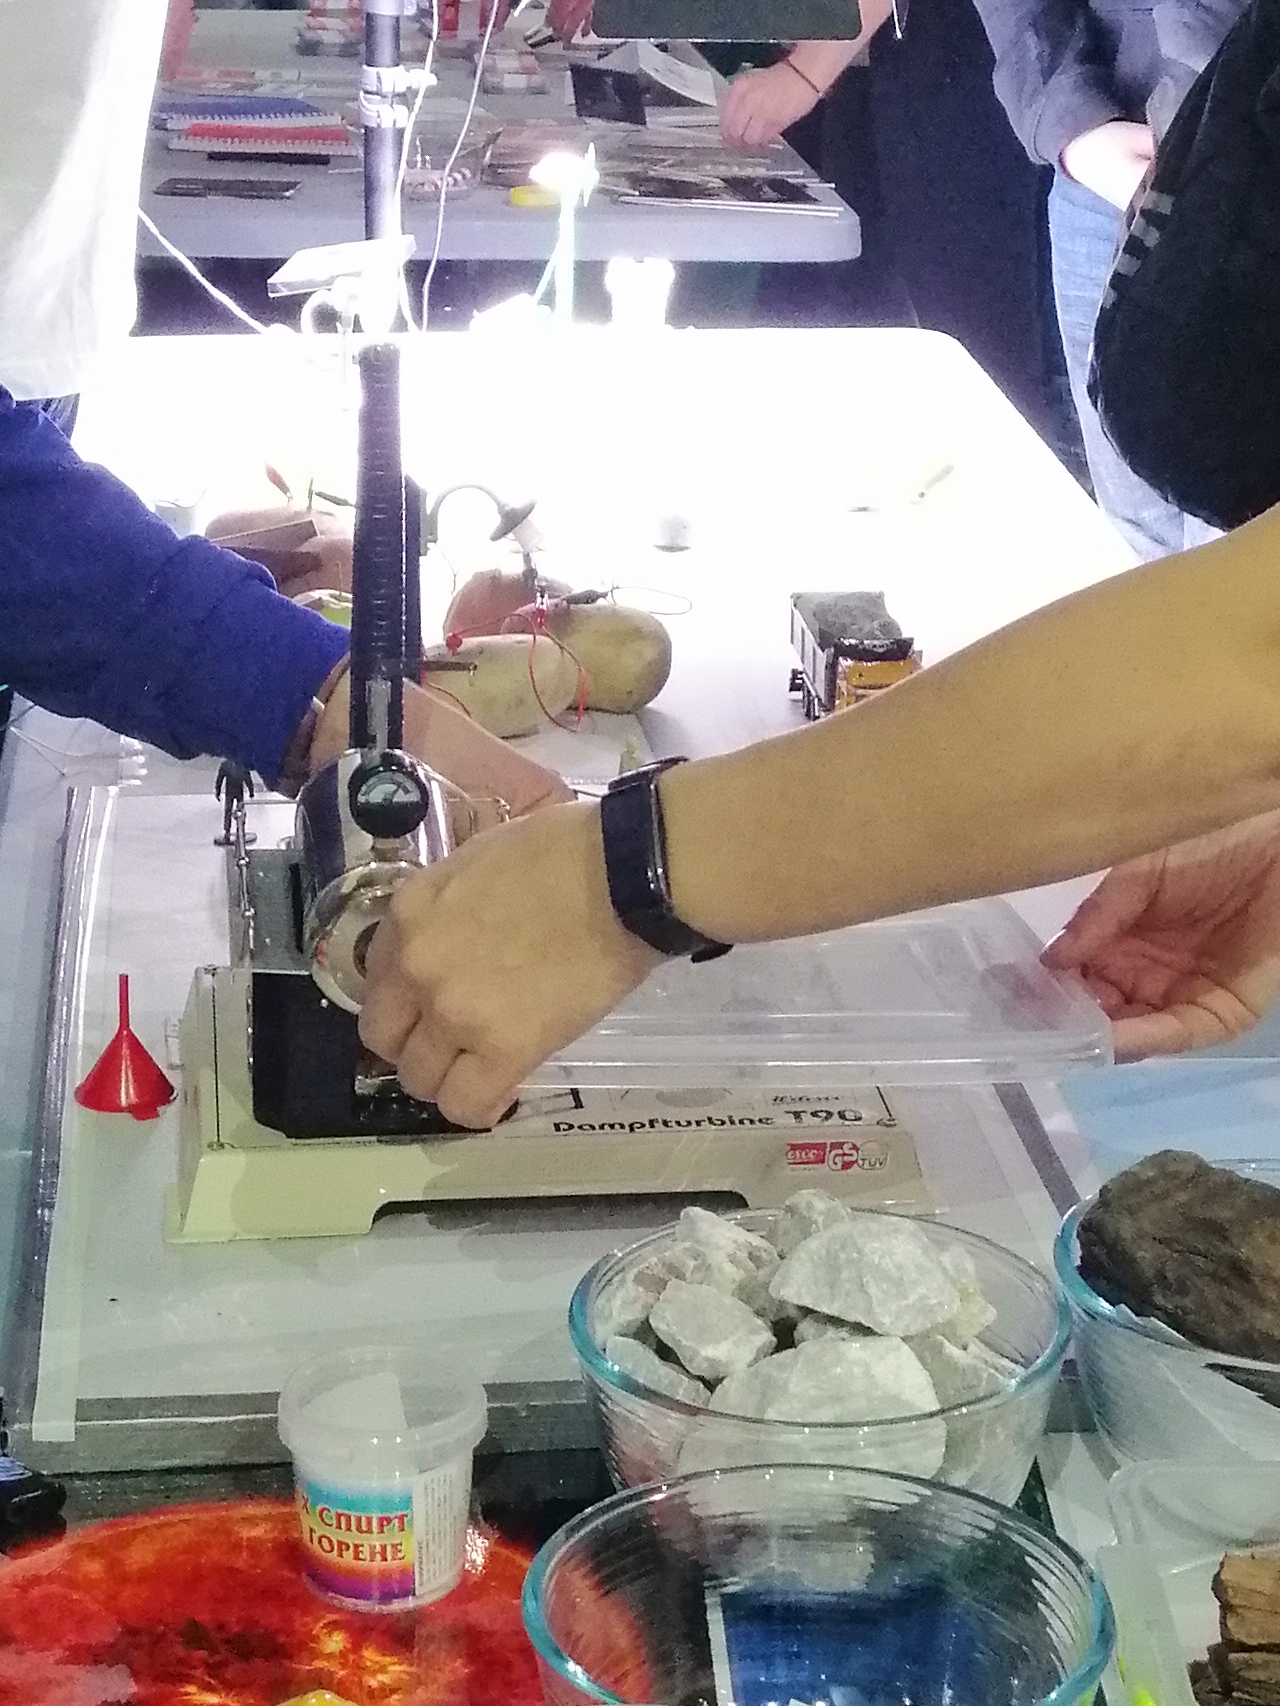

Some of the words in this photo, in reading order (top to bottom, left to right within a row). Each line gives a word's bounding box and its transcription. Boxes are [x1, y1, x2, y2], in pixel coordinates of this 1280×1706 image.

[553, 1112, 774, 1134] Dampfturbine
[784, 1108, 864, 1123] T90
[318, 1505, 409, 1535] СПИРТ
[308, 1525, 406, 1562] ГОРЕНЕ
